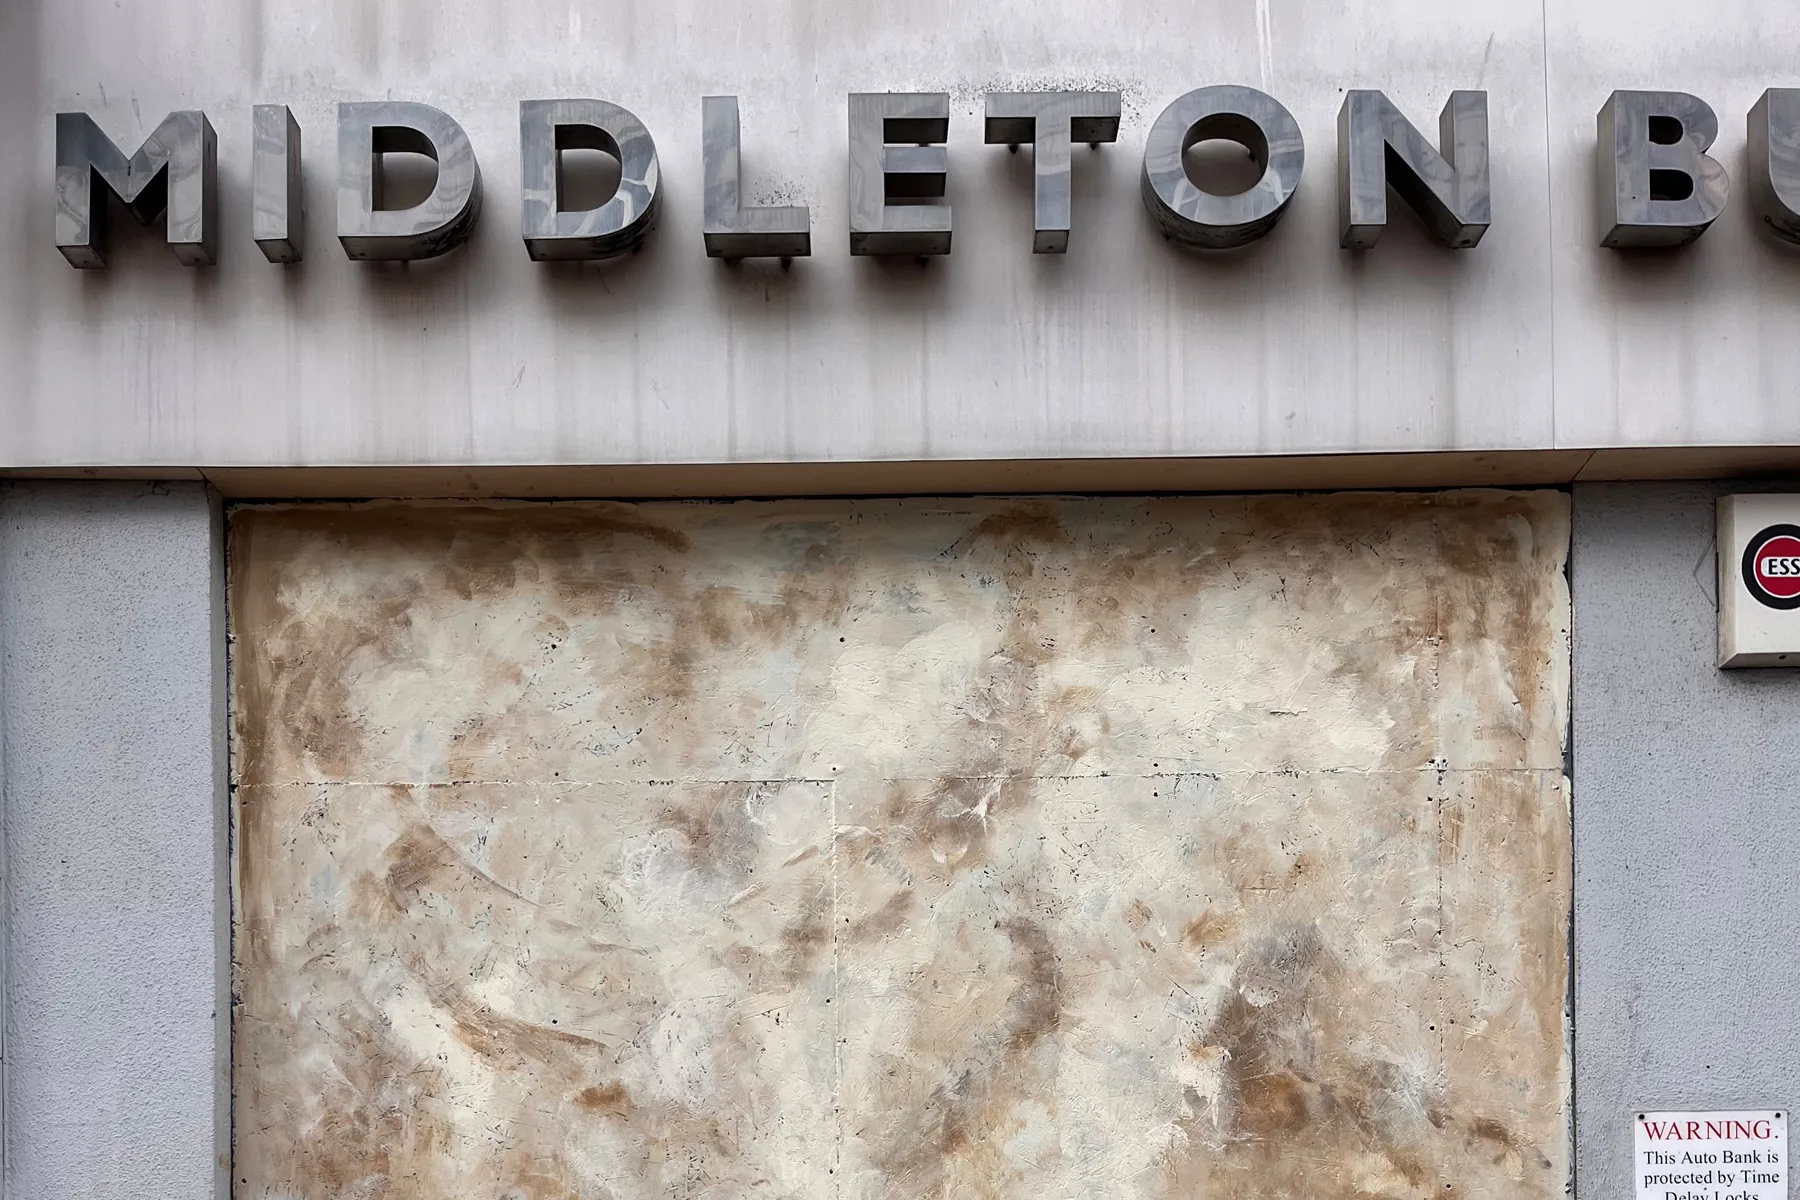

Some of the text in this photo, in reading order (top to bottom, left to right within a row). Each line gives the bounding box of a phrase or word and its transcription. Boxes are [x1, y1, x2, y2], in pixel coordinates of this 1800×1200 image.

[55, 84, 1491, 267] MIDDLETON
[1643, 1119, 1779, 1140] WARNING.
[1644, 1149, 1779, 1165] This Auto Bank is
[1644, 1169, 1780, 1188] protected by Time
